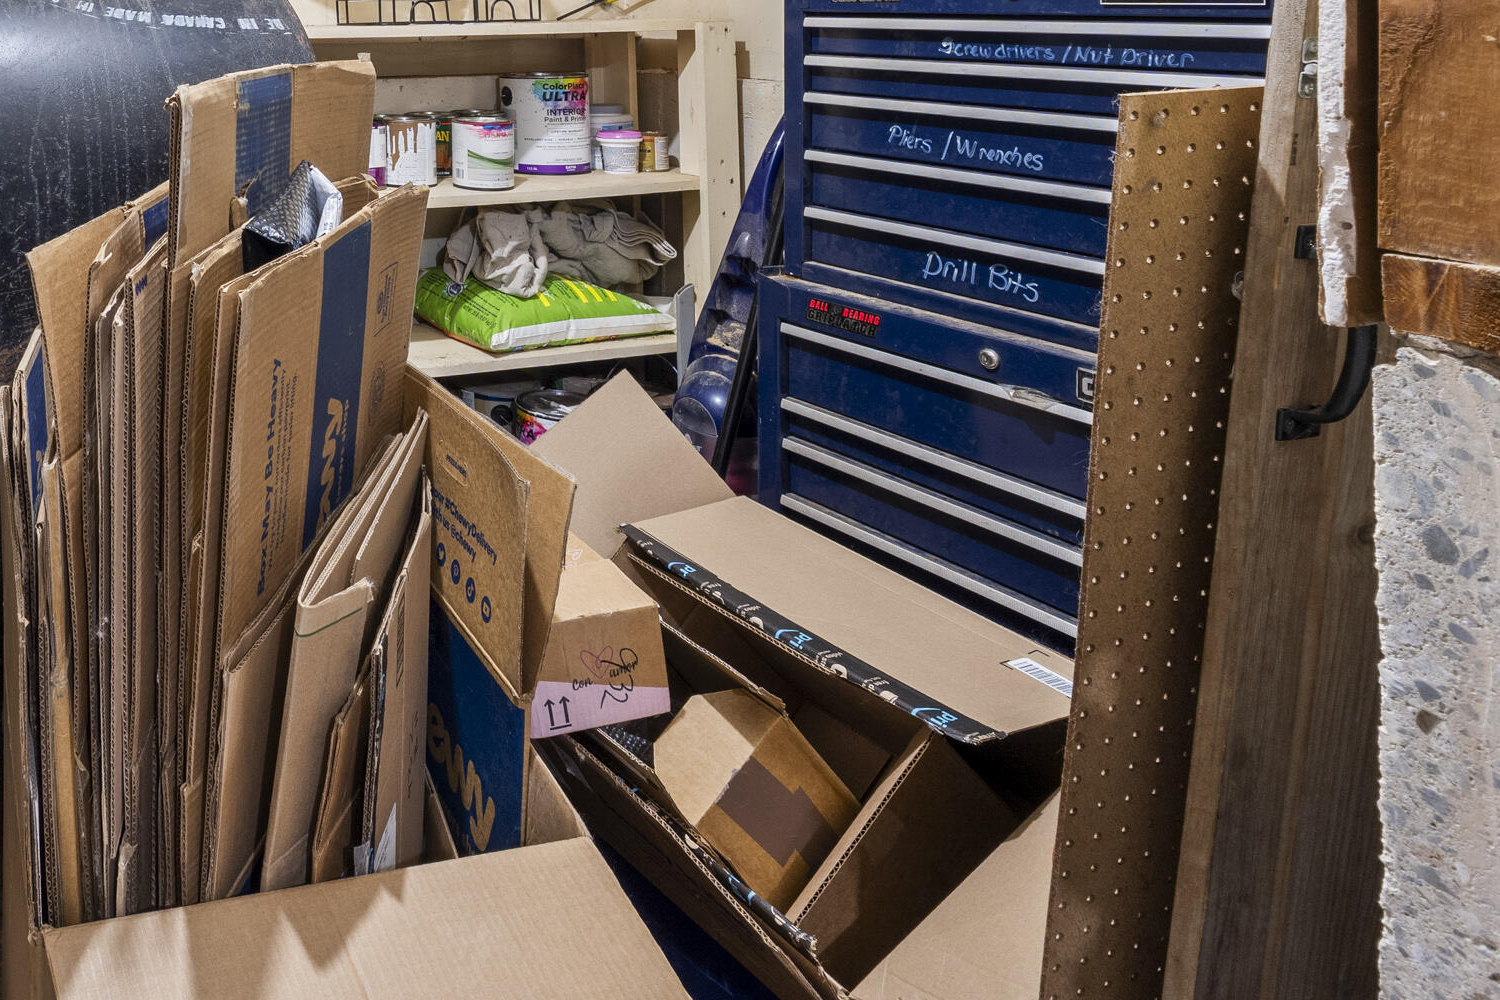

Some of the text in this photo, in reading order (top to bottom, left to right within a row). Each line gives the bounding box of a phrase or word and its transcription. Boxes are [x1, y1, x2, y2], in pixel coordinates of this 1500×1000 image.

[104, 7, 151, 23] MADE
[161, 15, 225, 29] CANADA
[1121, 48, 1194, 67] Driver
[542, 83, 585, 91] ColorPlac
[542, 91, 586, 102] ULTRA
[436, 131, 450, 142] AN
[888, 125, 932, 153] Pliers
[922, 251, 1039, 303] Drill Bits
[809, 299, 880, 326] BALL BEARING
[257, 358, 281, 597] Box May Be Heavy
[430, 485, 445, 504] our
[445, 497, 497, 566] #ChewyDelivery
[572, 678, 593, 691] con
